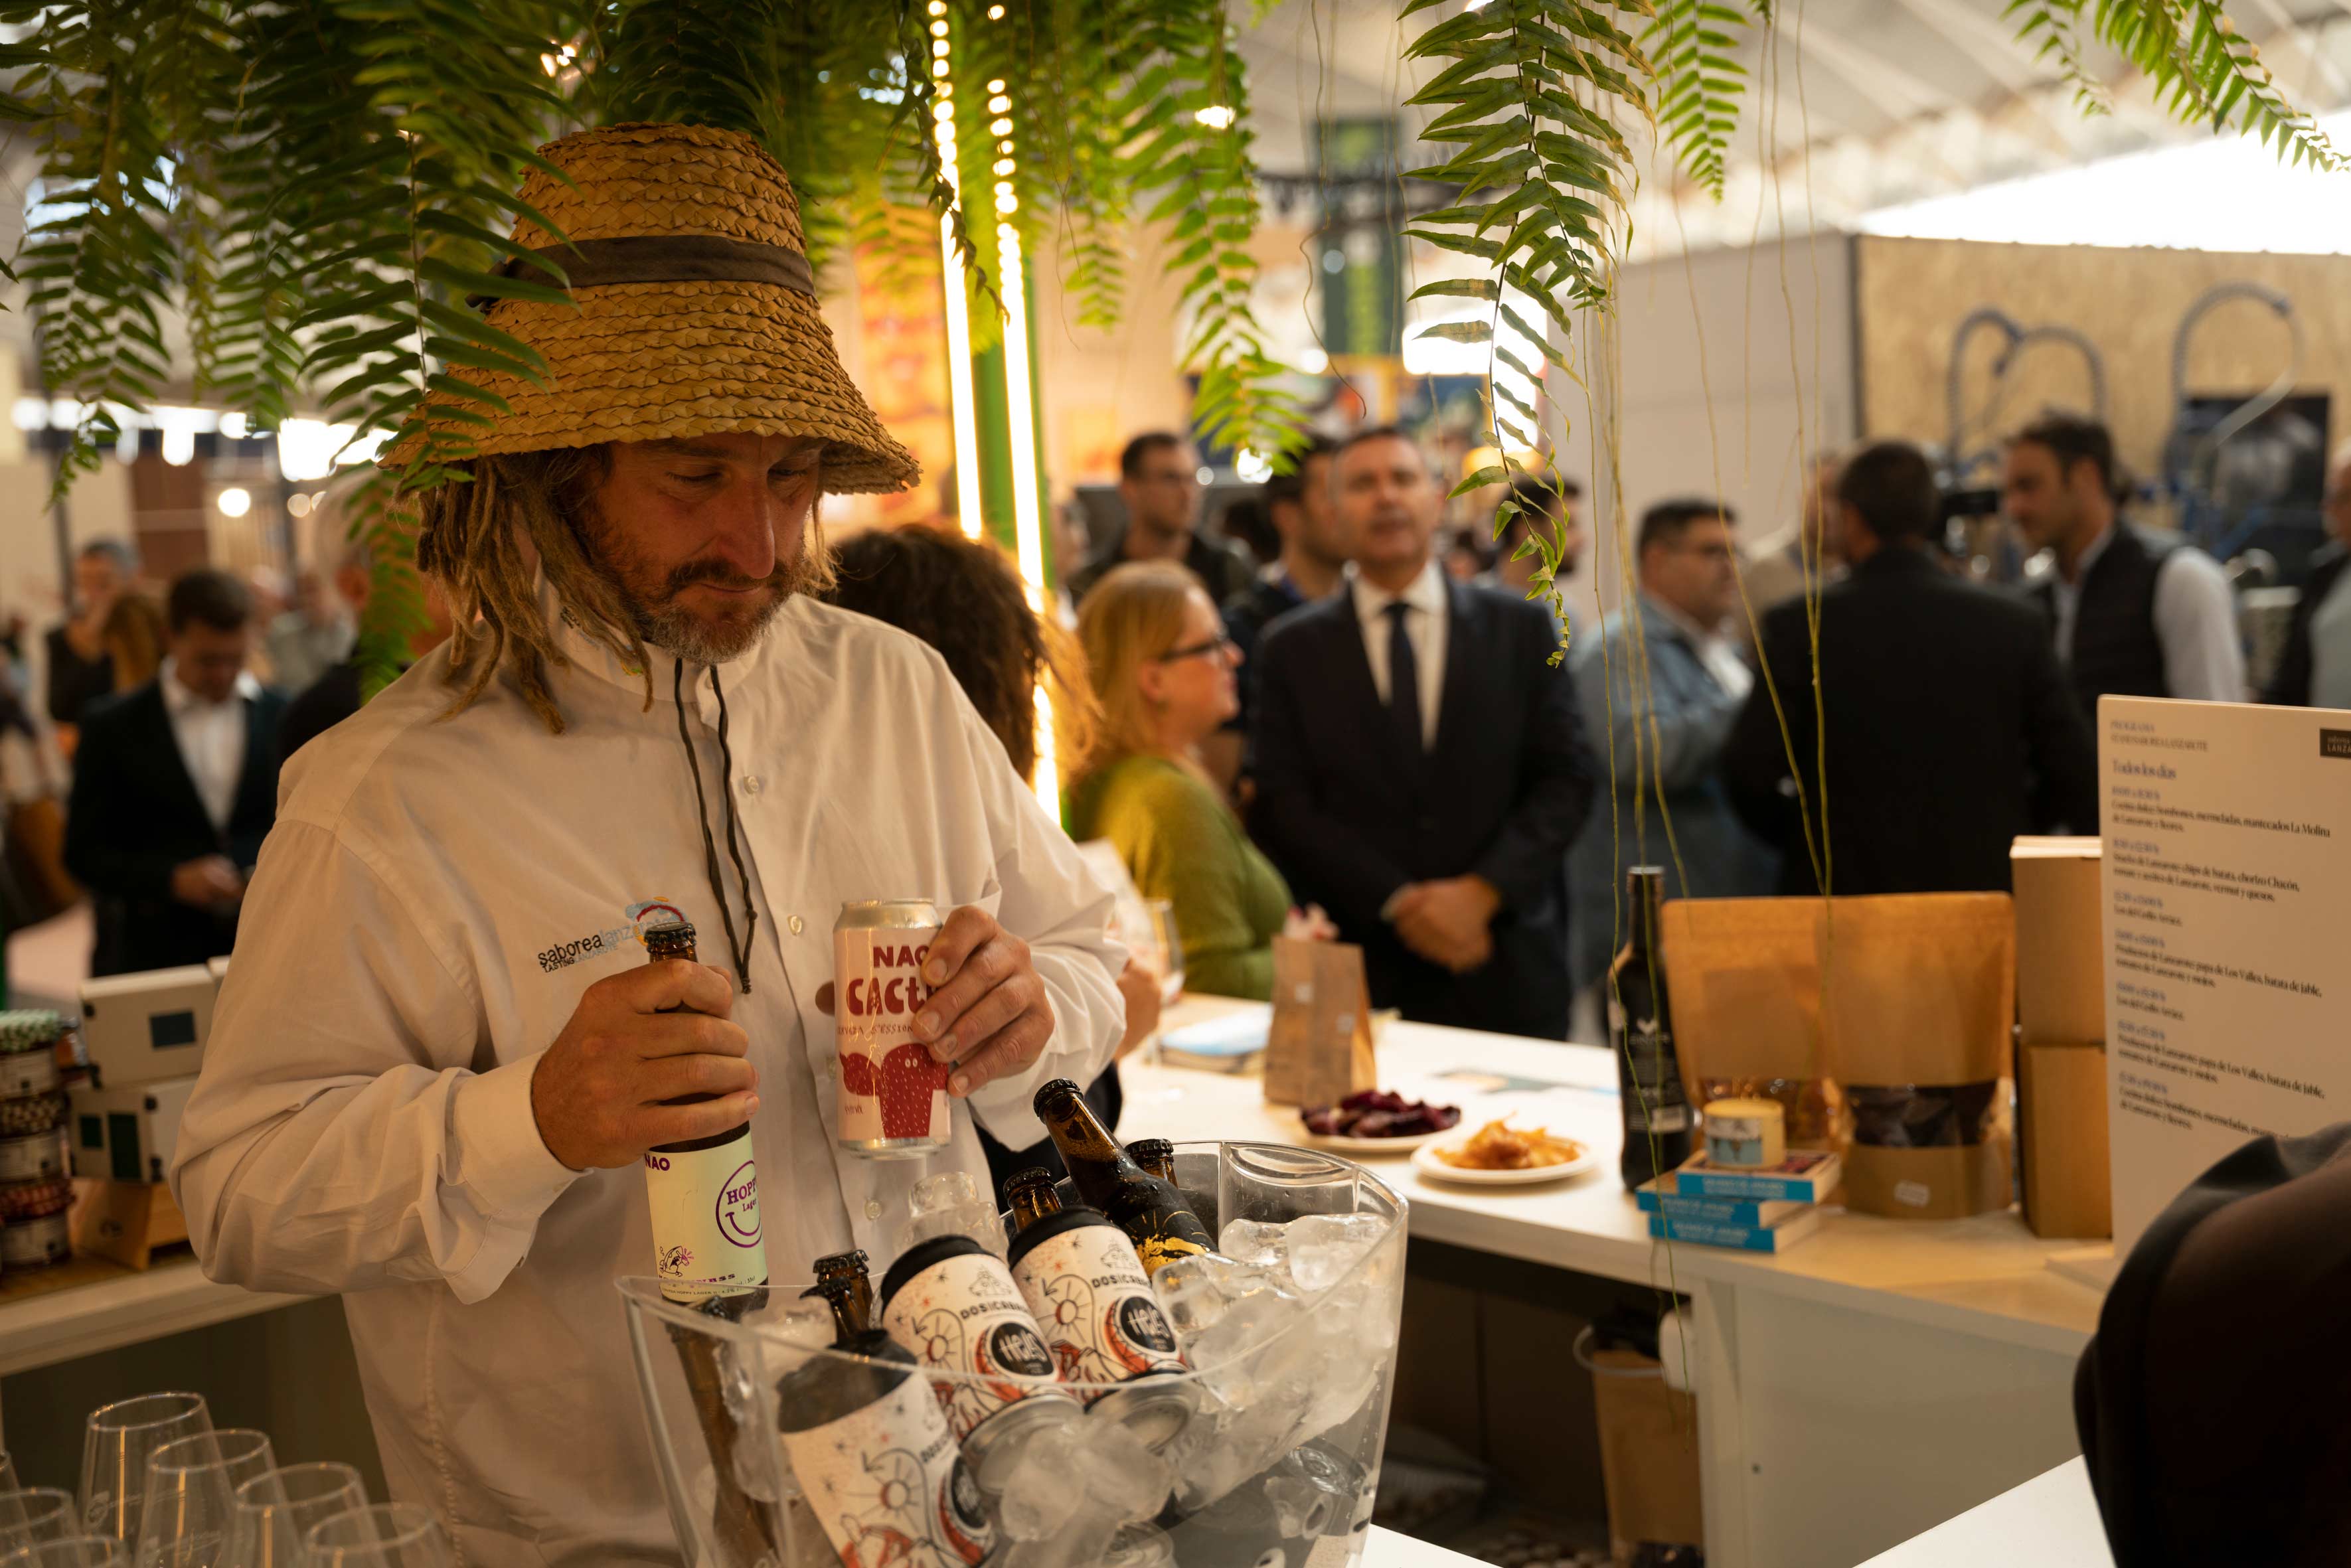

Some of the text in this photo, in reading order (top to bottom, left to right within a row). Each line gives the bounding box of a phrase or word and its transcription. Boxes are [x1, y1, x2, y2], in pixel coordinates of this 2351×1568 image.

[2291, 821, 2300, 833] La
[2302, 823, 2330, 838] Molina
[538, 935, 604, 967] saborea
[542, 957, 576, 974] TASTING
[2290, 979, 2300, 993] de
[847, 977, 935, 1016] CACt
[2291, 1079, 2302, 1093] de
[644, 1153, 671, 1172] NAO
[726, 1174, 757, 1206] HOPP
